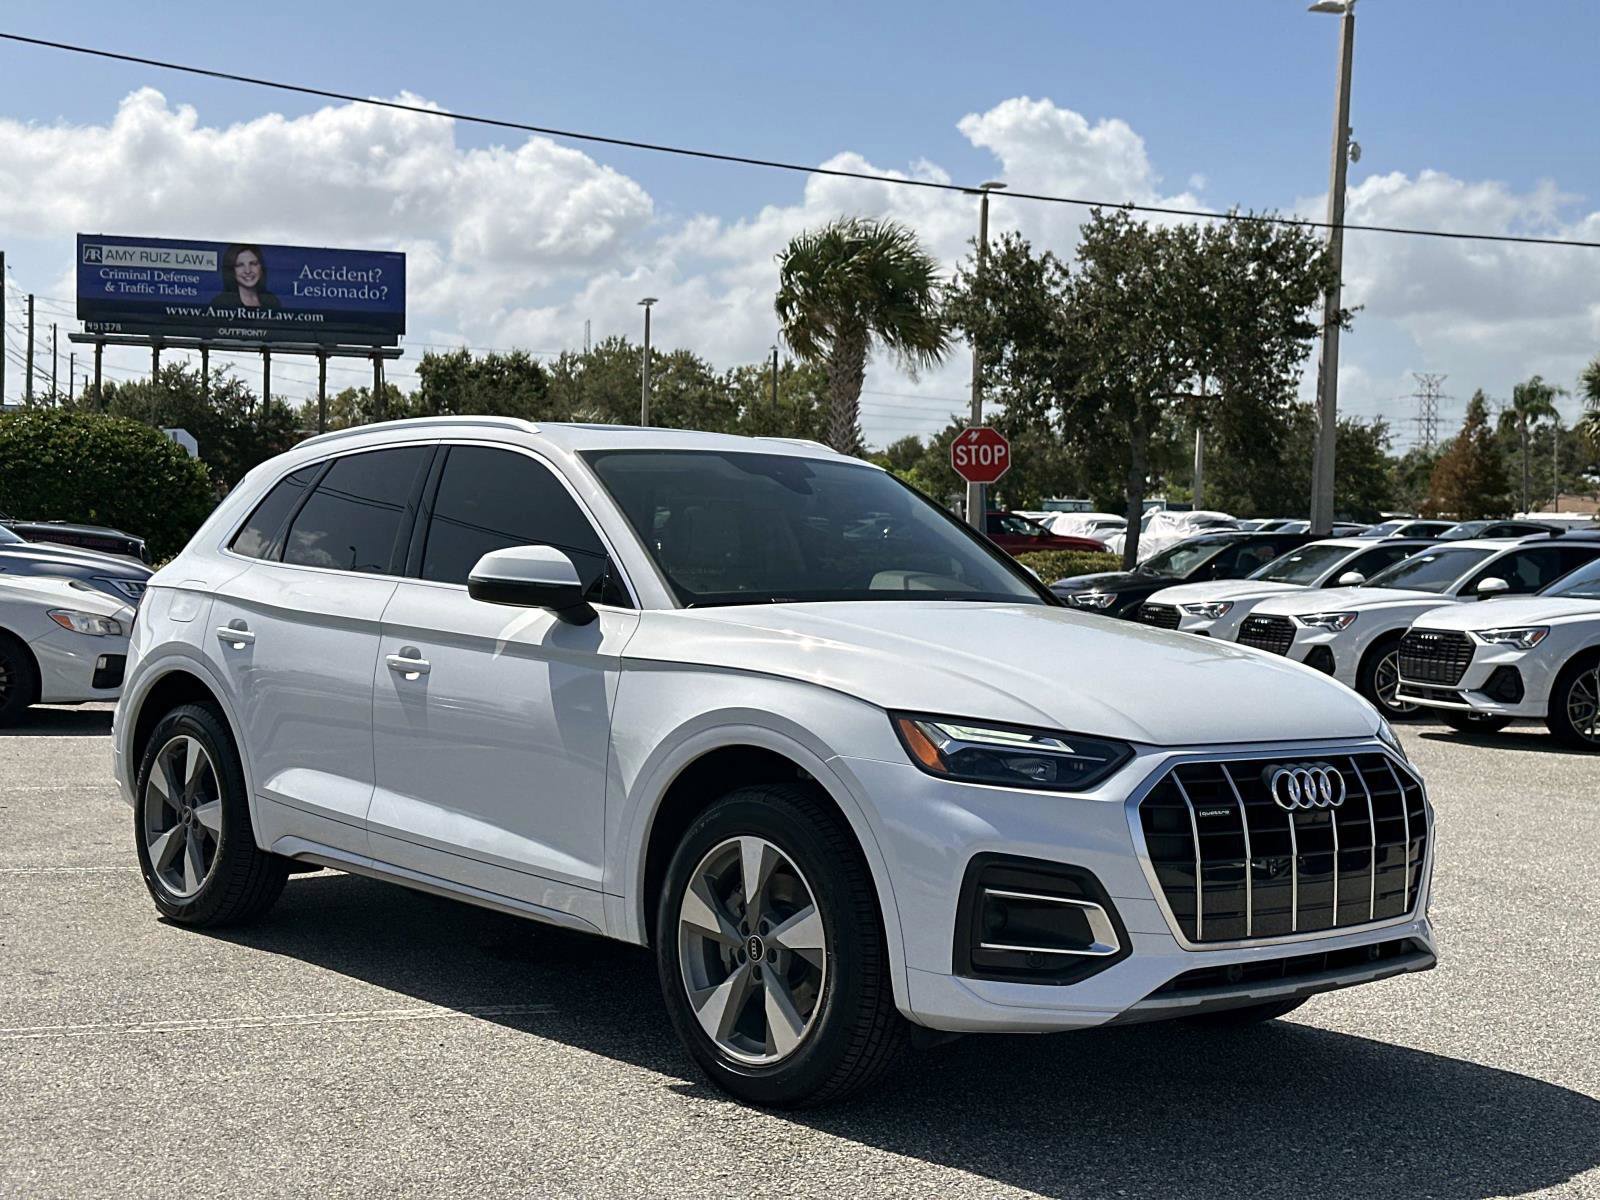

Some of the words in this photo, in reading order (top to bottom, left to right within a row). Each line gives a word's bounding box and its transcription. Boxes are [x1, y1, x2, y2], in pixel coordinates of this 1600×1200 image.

[105, 250, 136, 262] AMY
[140, 251, 170, 264] RUIZ
[175, 253, 204, 265] LAW
[99, 268, 151, 281] Criminal
[153, 270, 200, 284] Defense
[298, 264, 383, 283] Accident?
[104, 282, 115, 292] &
[118, 282, 155, 295] Traffic
[158, 284, 198, 297] Tickets
[292, 281, 388, 300] Lesionado?
[165, 306, 325, 322] www.AmyRuizLaw.com
[955, 444, 1006, 466] STOP
